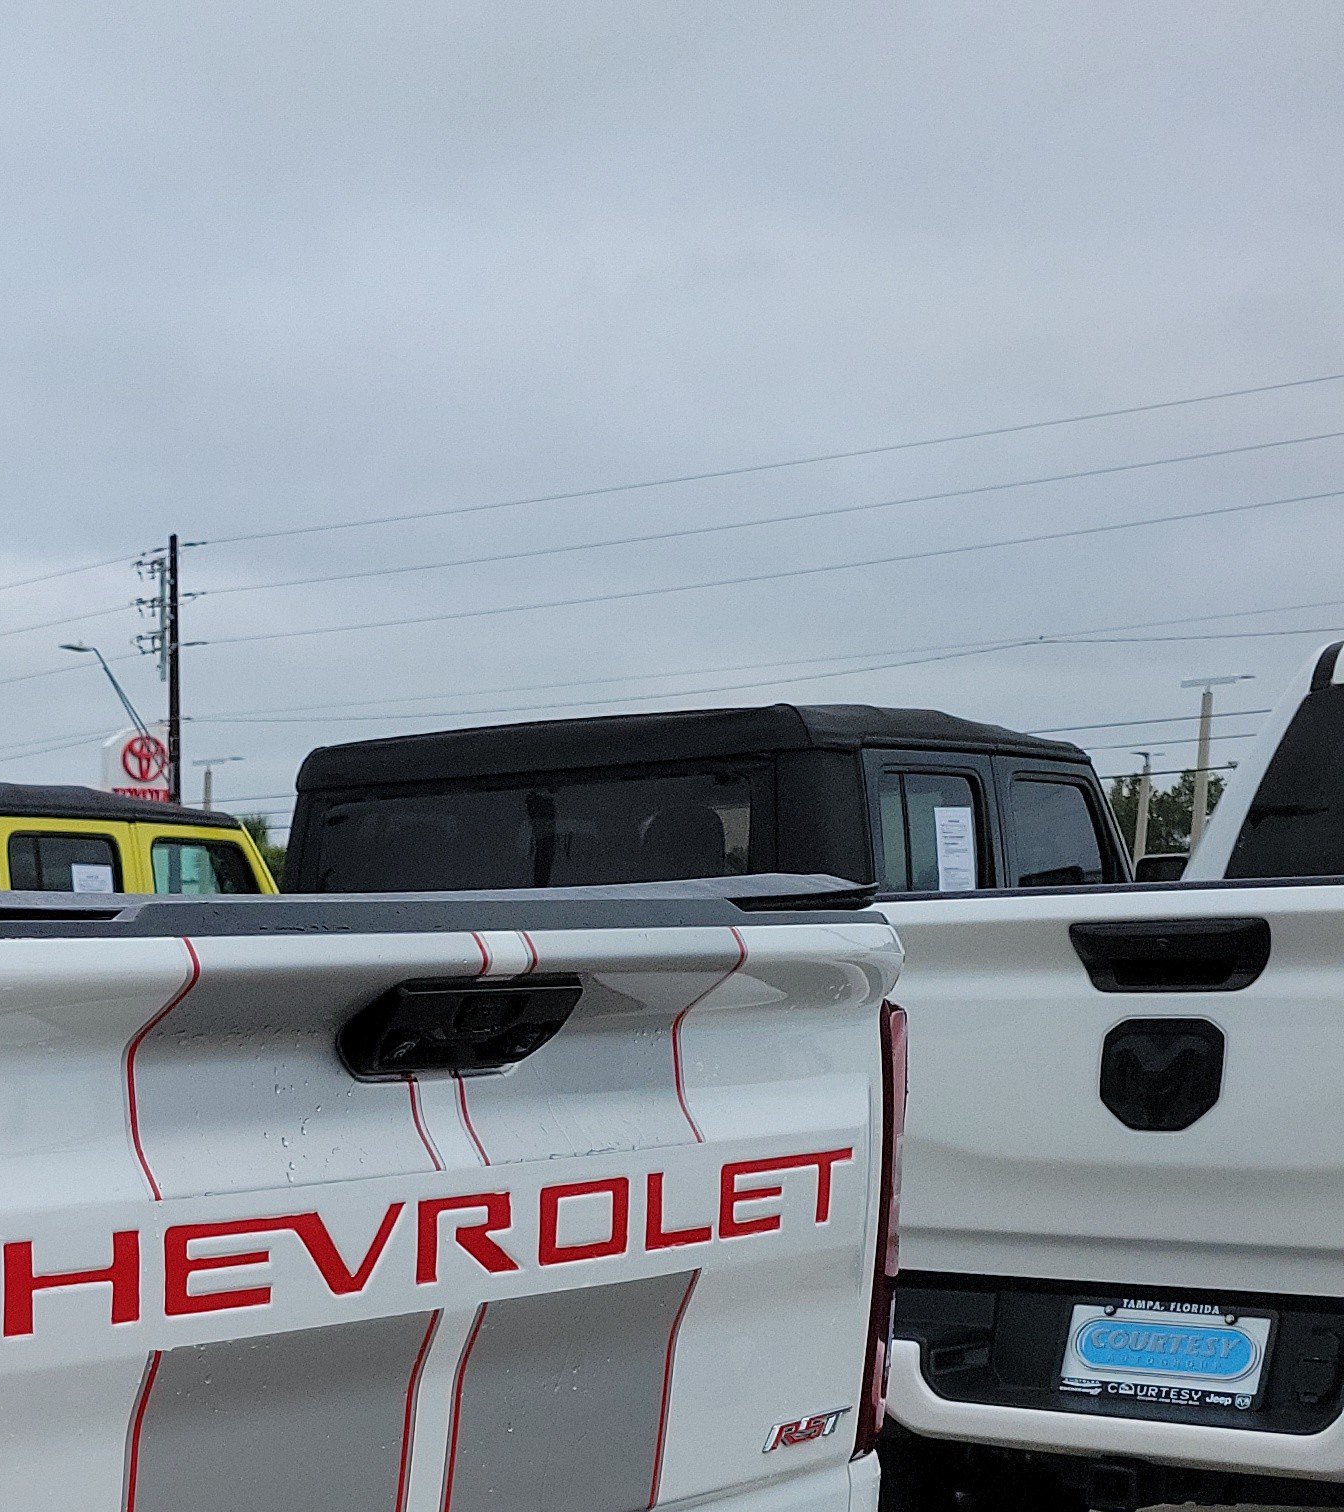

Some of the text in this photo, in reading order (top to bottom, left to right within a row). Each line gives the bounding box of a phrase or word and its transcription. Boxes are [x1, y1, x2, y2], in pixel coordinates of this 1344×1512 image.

[1122, 1299, 1220, 1315] TAMPA, FLORIDA
[1090, 1327, 1242, 1359] COURTESY
[1205, 1393, 1232, 1406] Jeep
[762, 1406, 853, 1453] RST
